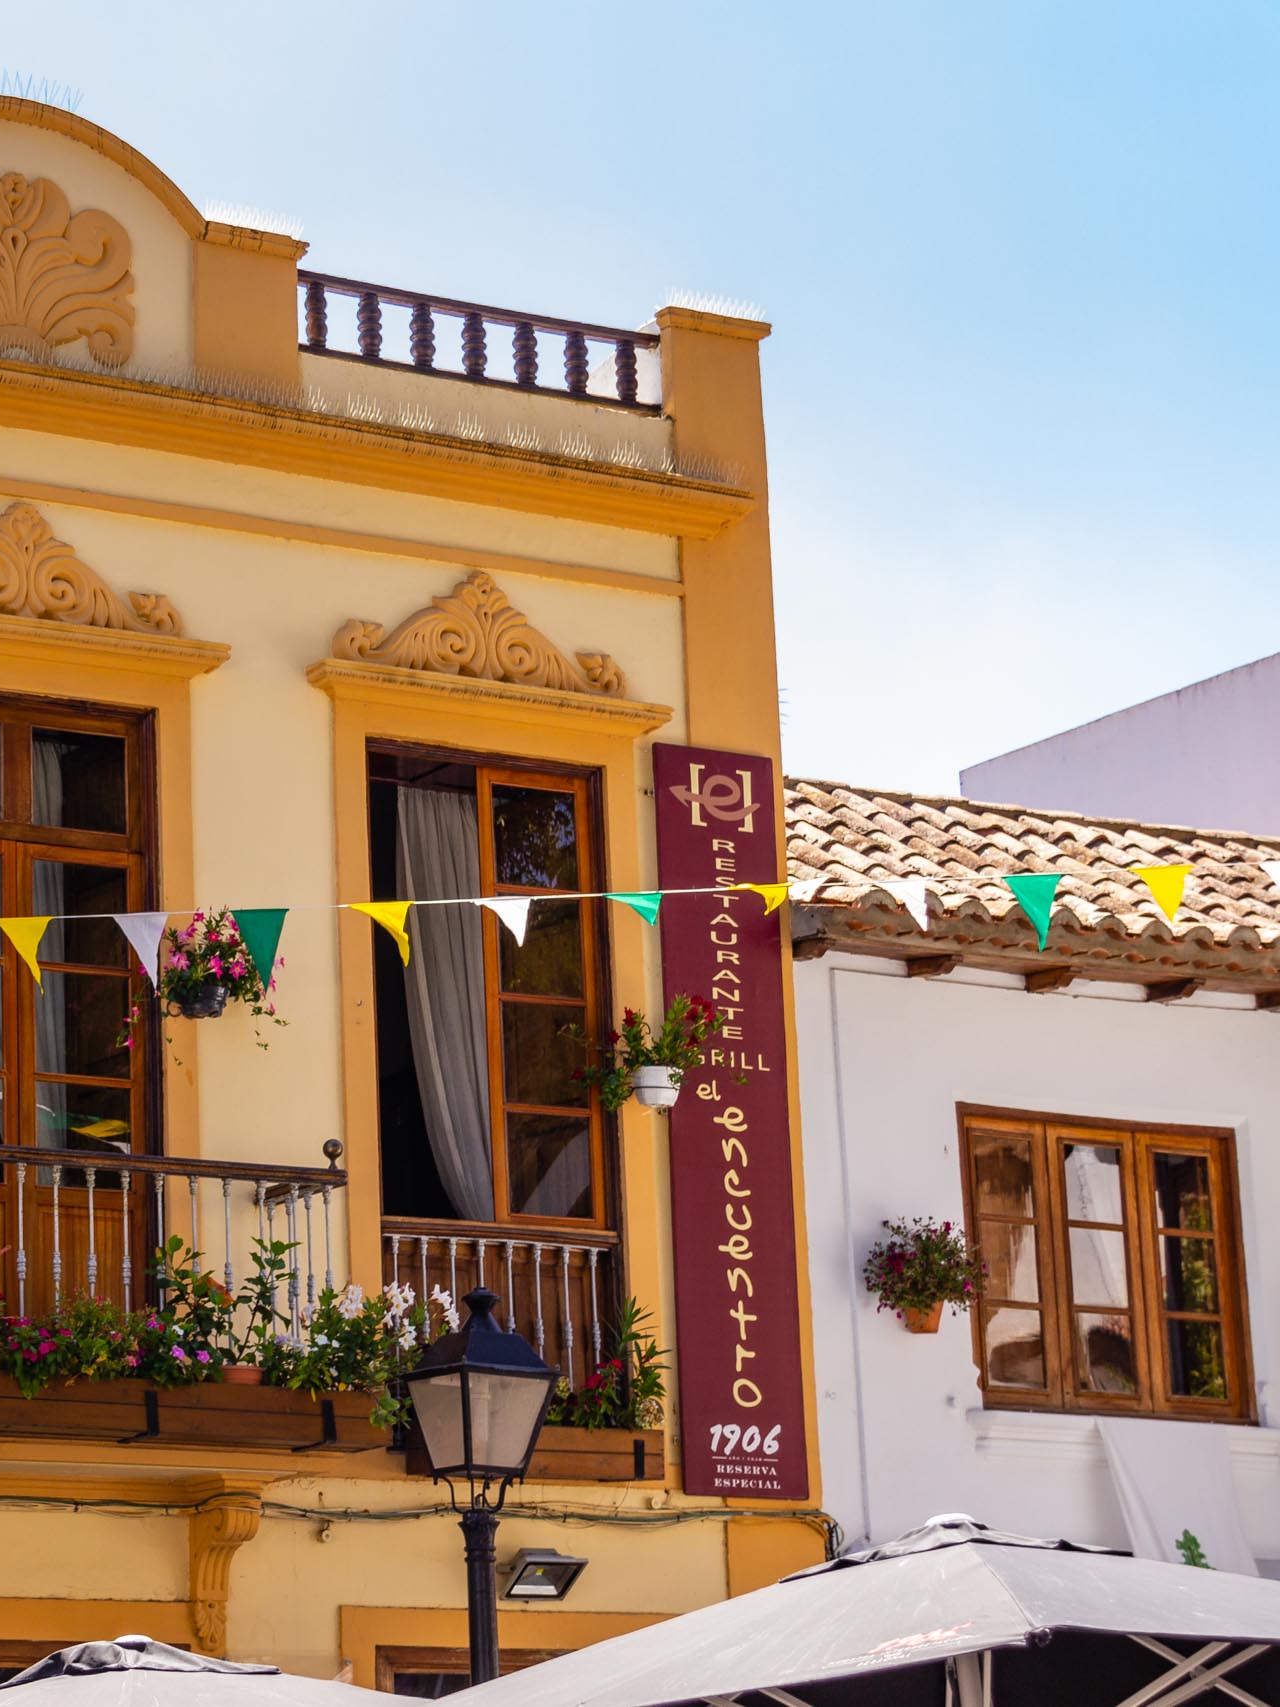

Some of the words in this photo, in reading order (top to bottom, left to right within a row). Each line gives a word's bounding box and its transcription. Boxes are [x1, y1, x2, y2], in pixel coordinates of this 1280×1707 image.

[709, 838, 744, 1040] RESTAURANTE
[696, 1080, 721, 1101] el
[713, 1106, 762, 1408] encuentro
[710, 1424, 781, 1455] 1906
[716, 1464, 777, 1476] RESERVA
[714, 1478, 781, 1490] ESPECIAL
